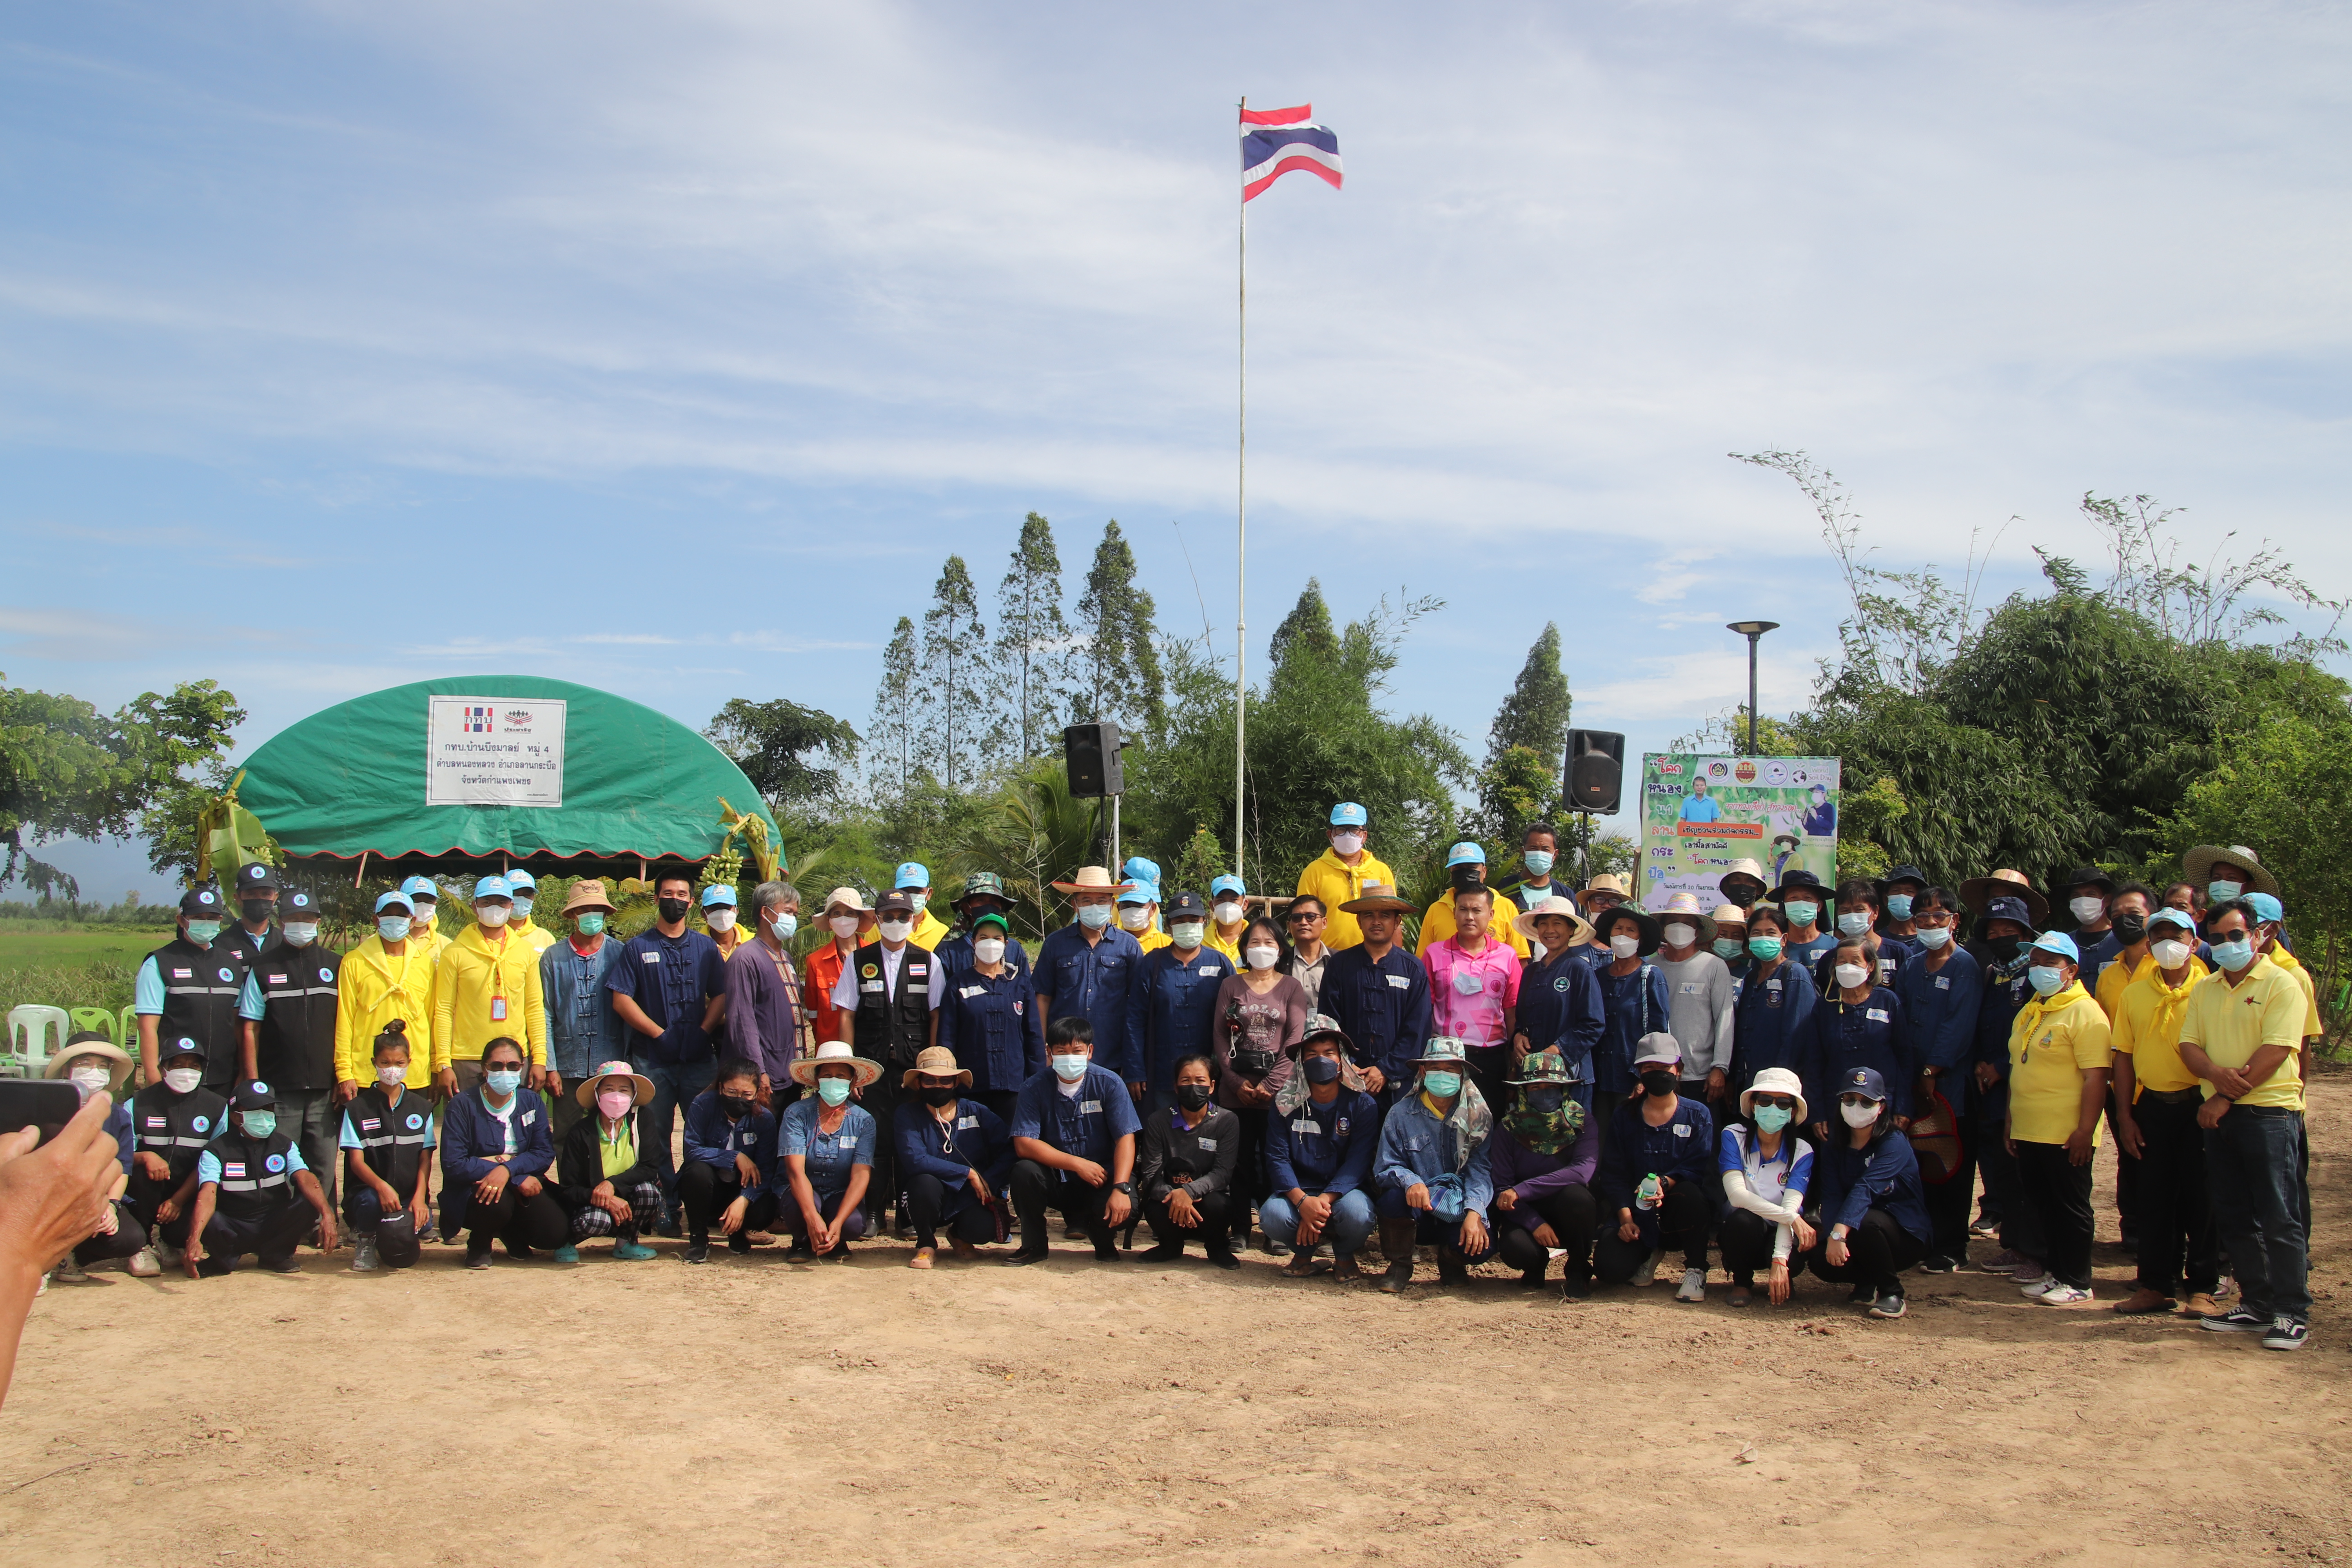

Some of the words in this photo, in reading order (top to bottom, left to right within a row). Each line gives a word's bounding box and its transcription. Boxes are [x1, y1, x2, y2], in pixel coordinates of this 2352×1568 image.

[527, 742, 540, 756] หมู่
[437, 758, 495, 768] ตำบลหนองหลวง
[498, 759, 556, 769] อำเภอลานกระบือ
[461, 775, 531, 785] จังหวัดกำแพงเพชร
[1820, 774, 1831, 783] Day
[1648, 783, 1682, 794] หนอง
[1656, 804, 1673, 815] นา
[1726, 801, 1764, 810] จากทางเลือก
[1651, 826, 1675, 835] ลาน
[1651, 847, 1673, 856] กระ
